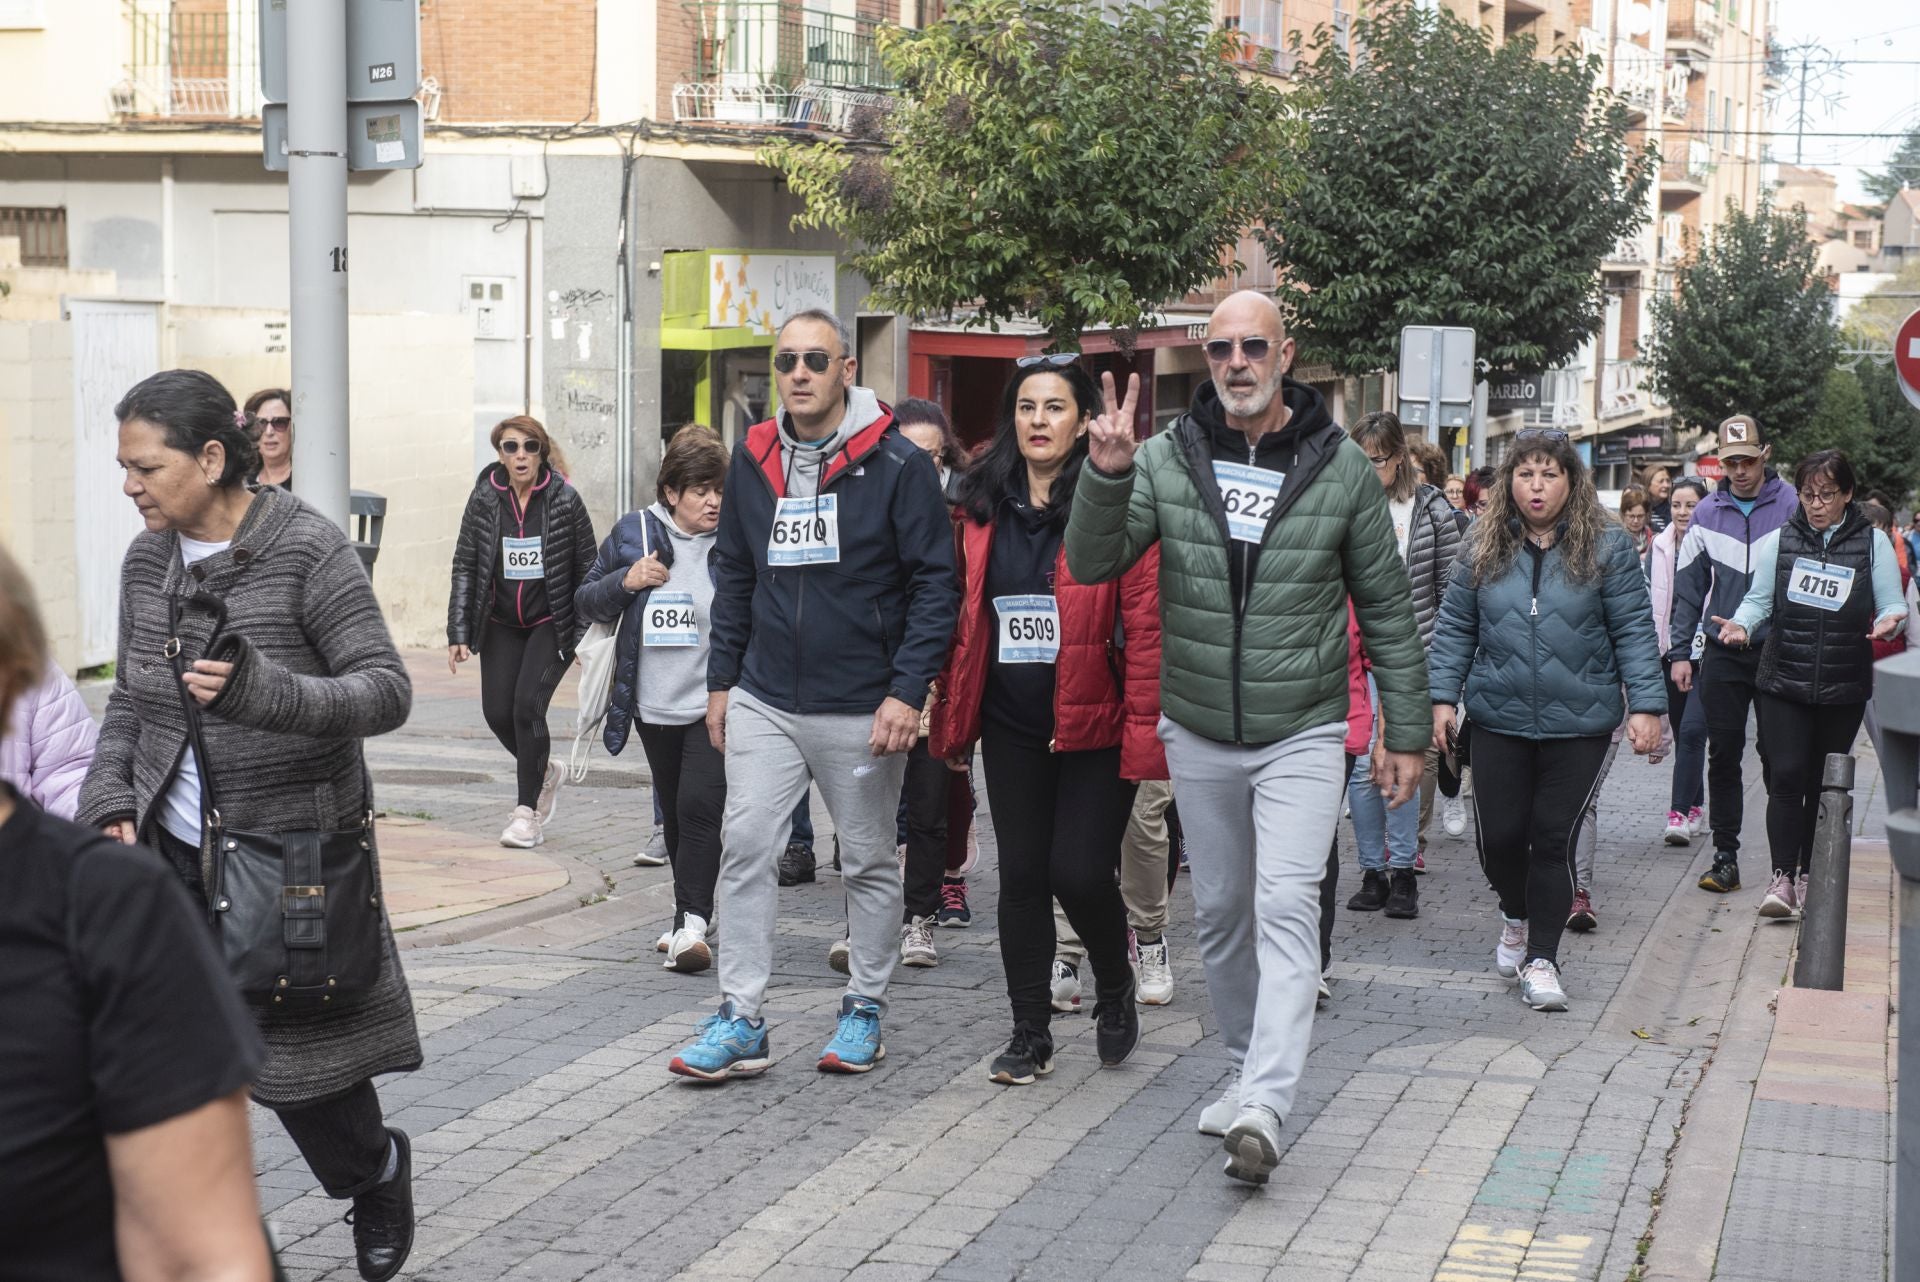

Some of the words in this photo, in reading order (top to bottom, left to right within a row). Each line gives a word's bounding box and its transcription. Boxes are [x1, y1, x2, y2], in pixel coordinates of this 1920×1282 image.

[371, 66, 393, 80] N26
[1219, 486, 1277, 520] 622
[773, 517, 827, 545] 6510
[508, 551, 542, 567] 662
[1798, 574, 1839, 598] 4715
[1008, 617, 1055, 642] 6509
